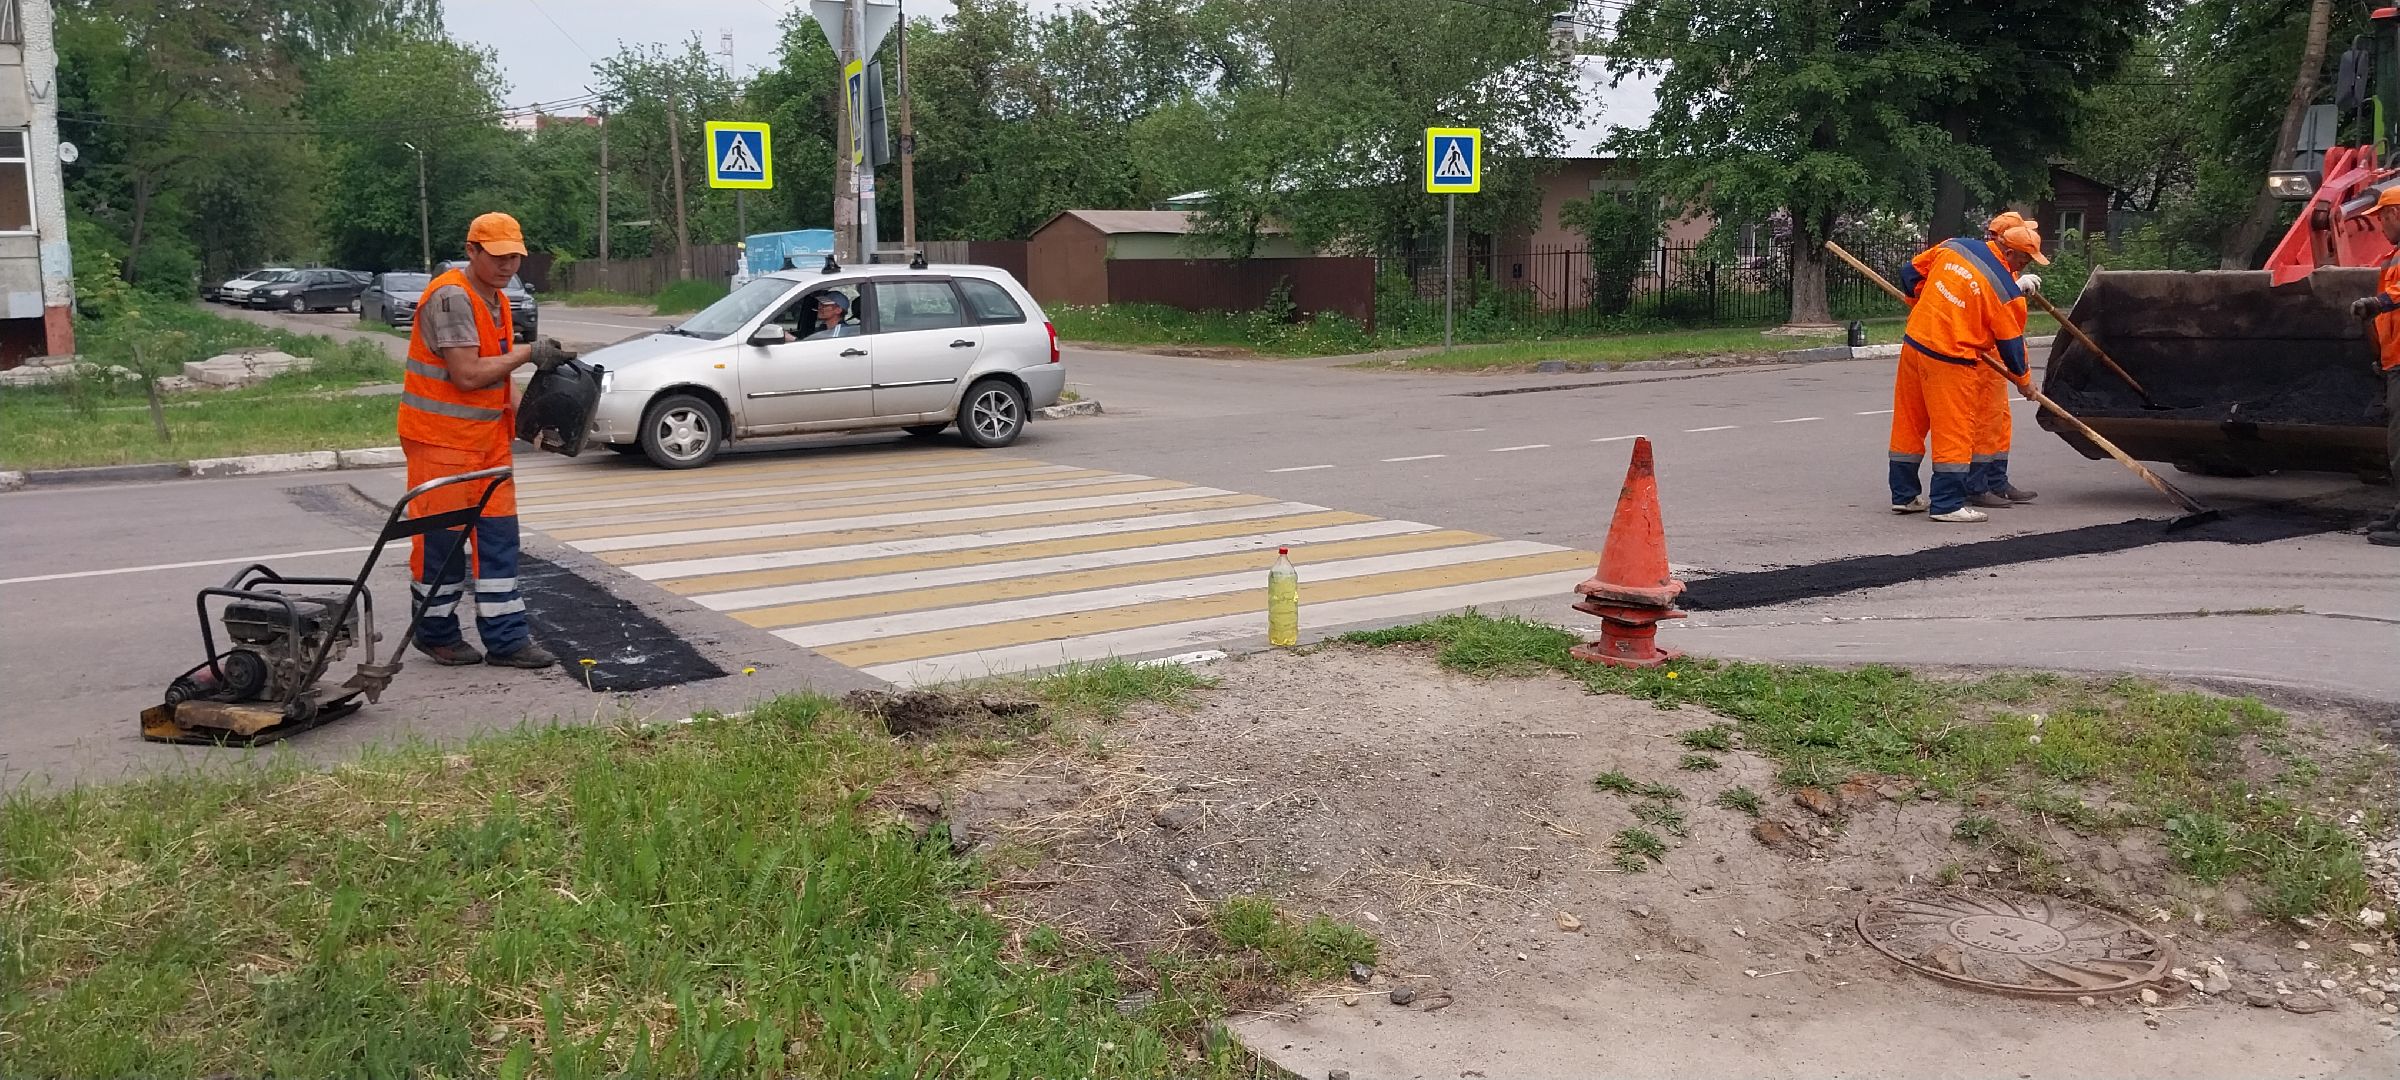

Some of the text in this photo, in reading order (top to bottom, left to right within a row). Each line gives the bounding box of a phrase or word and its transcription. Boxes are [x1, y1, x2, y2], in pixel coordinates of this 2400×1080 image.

[1935, 280, 1966, 308] КОЛОМНА
[1944, 263, 1981, 296] ЛИДЕР СК
